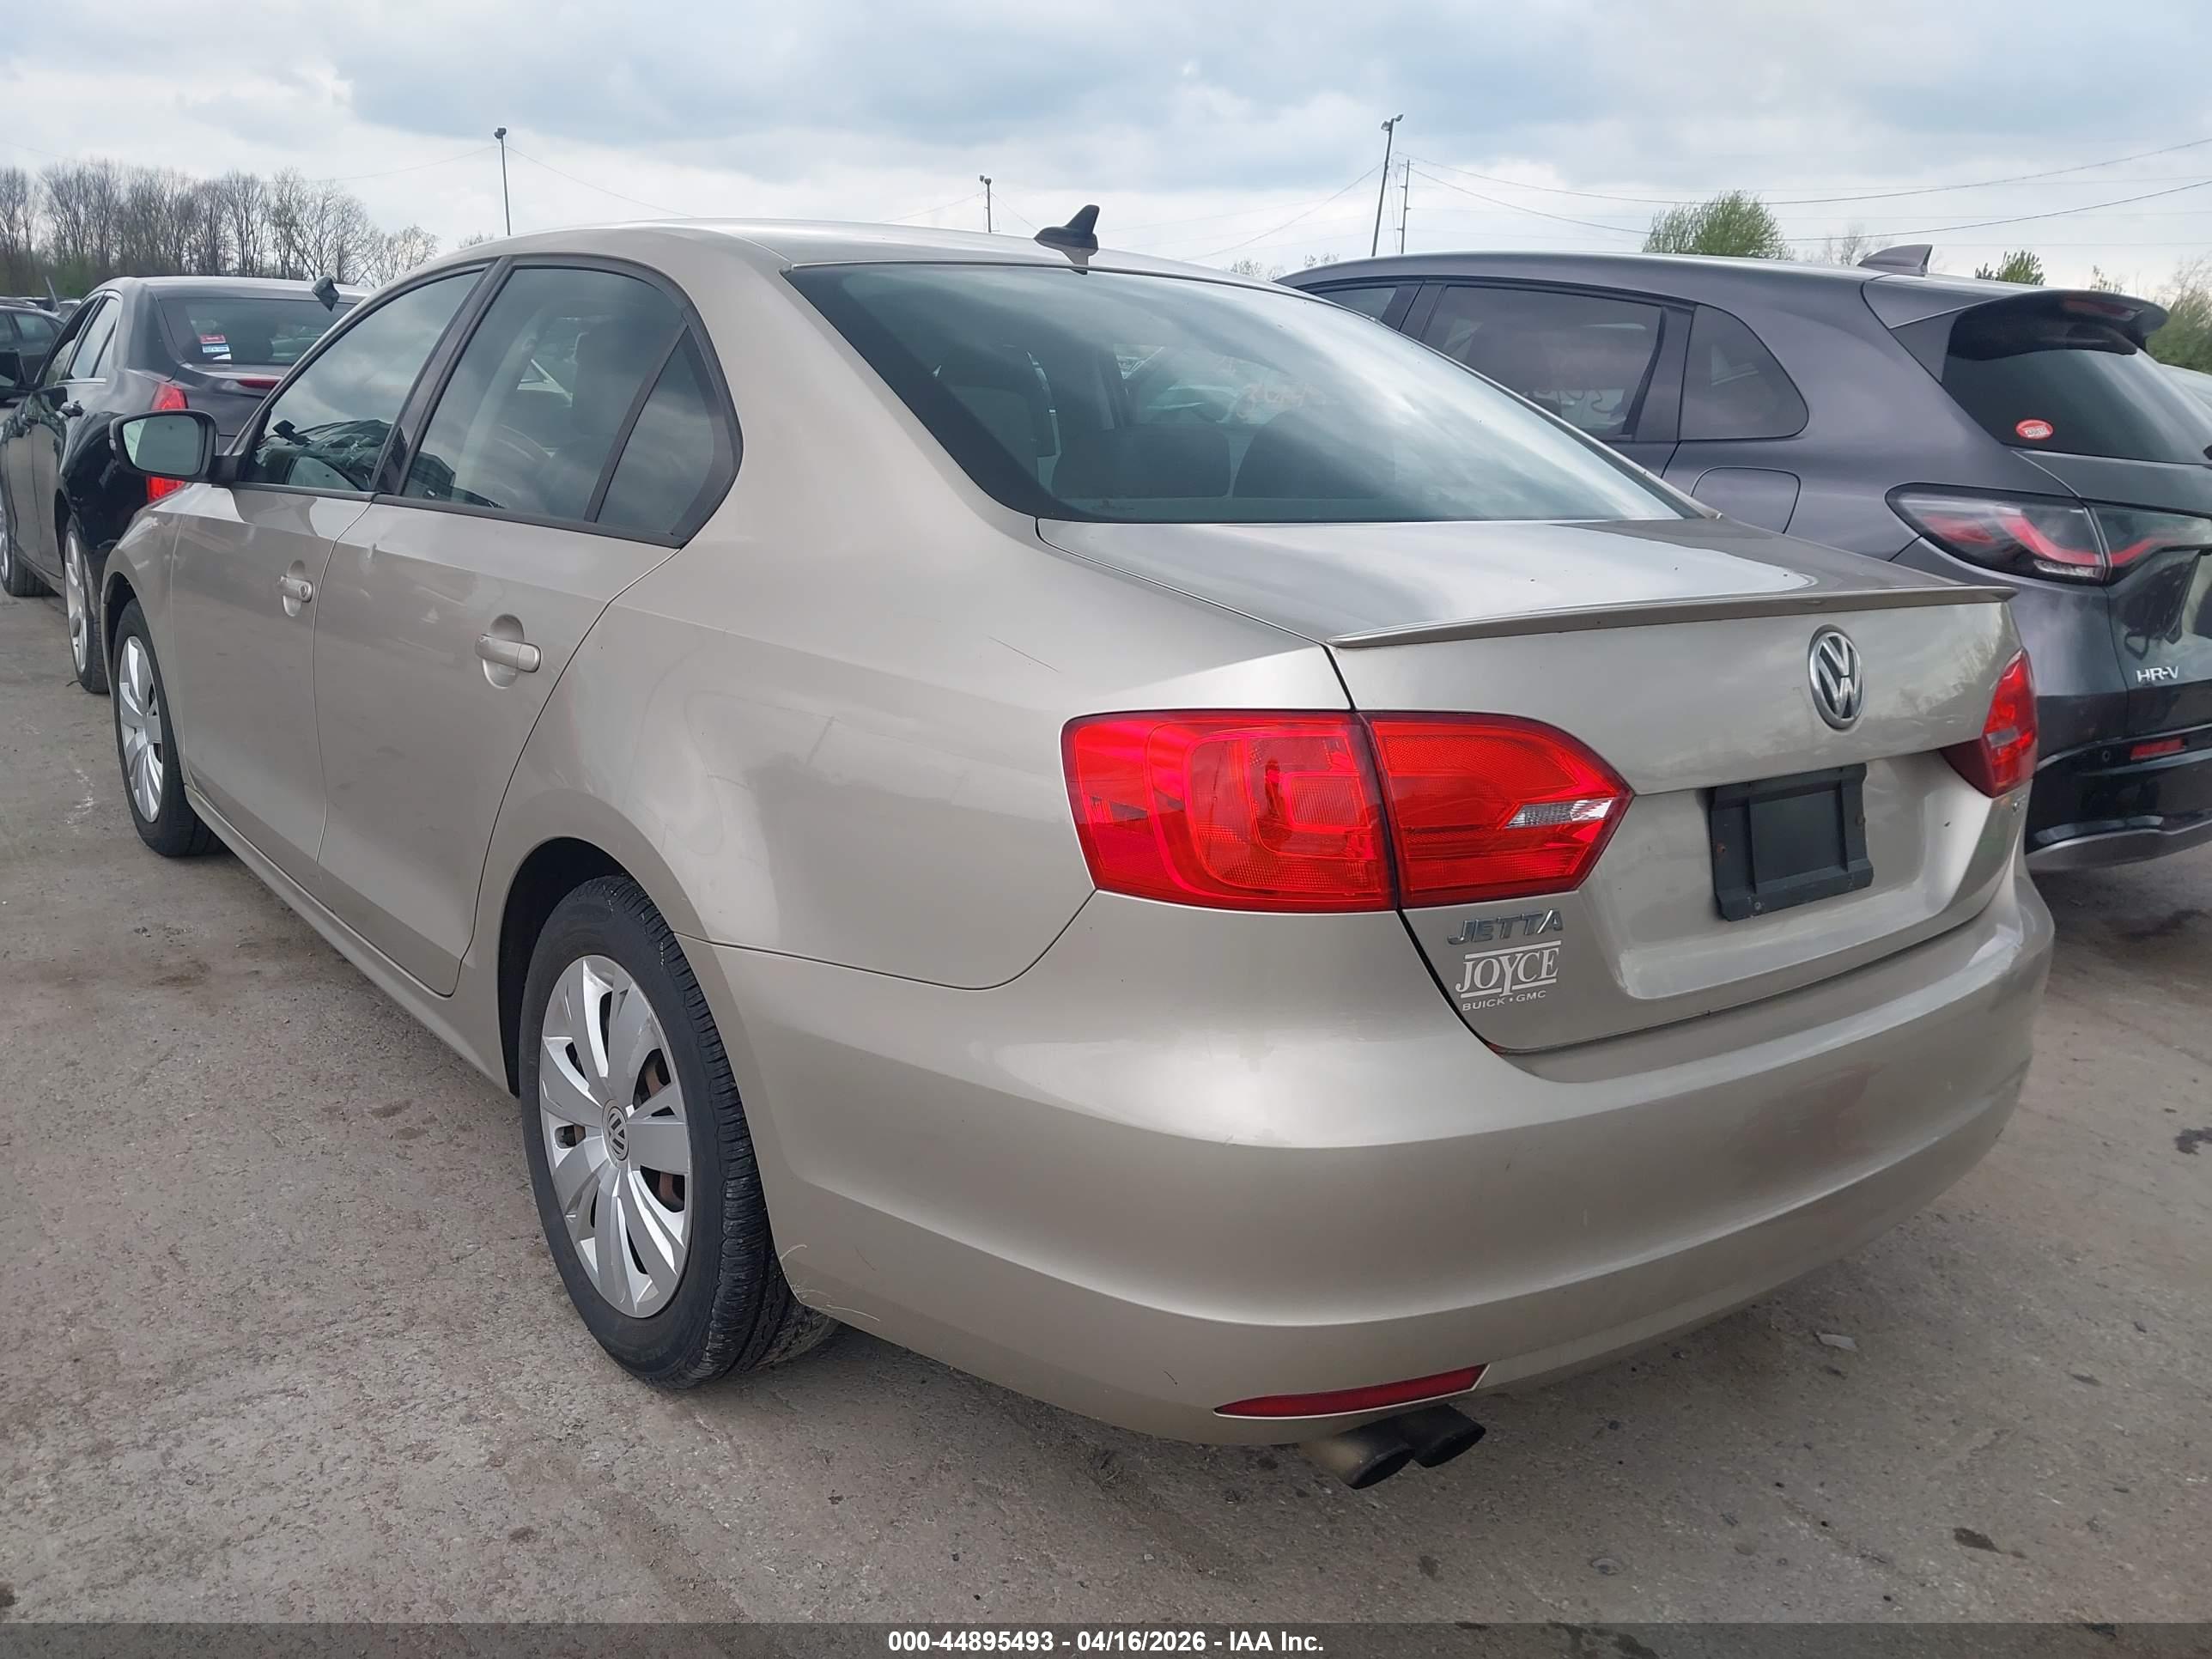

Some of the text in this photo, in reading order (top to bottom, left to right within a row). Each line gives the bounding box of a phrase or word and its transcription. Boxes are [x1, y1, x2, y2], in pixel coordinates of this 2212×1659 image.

[2136, 665, 2179, 683] HR-V
[1447, 908, 1564, 945] JETTA
[1455, 947, 1560, 998] JOYCE
[1462, 990, 1547, 1012] BUICK GMC
